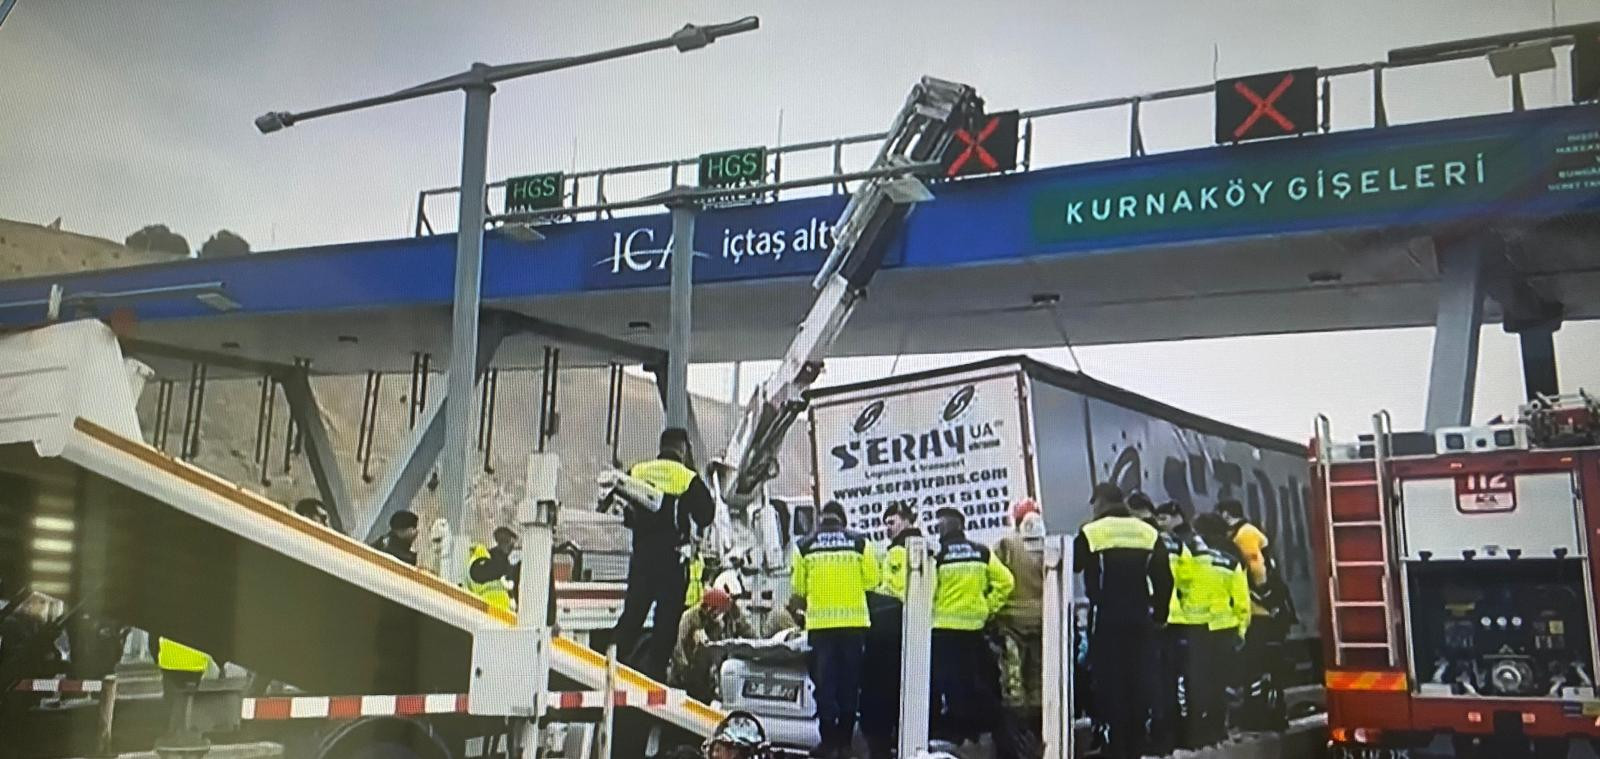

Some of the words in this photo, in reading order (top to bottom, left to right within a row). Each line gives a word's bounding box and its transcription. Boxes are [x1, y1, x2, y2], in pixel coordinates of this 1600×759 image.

[707, 152, 757, 179] HGS
[513, 176, 556, 200] HGS
[1066, 179, 1275, 225] KURNAKÖY
[1287, 152, 1487, 201] GİŞELERİ
[722, 228, 786, 263] içtaş
[831, 425, 965, 471] SERAY
[969, 422, 994, 439] UA
[834, 468, 1007, 500] www.seraytrans.com
[850, 502, 882, 515] +90
[922, 492, 955, 506] 451
[960, 489, 981, 502] 51
[986, 485, 1008, 498] 01
